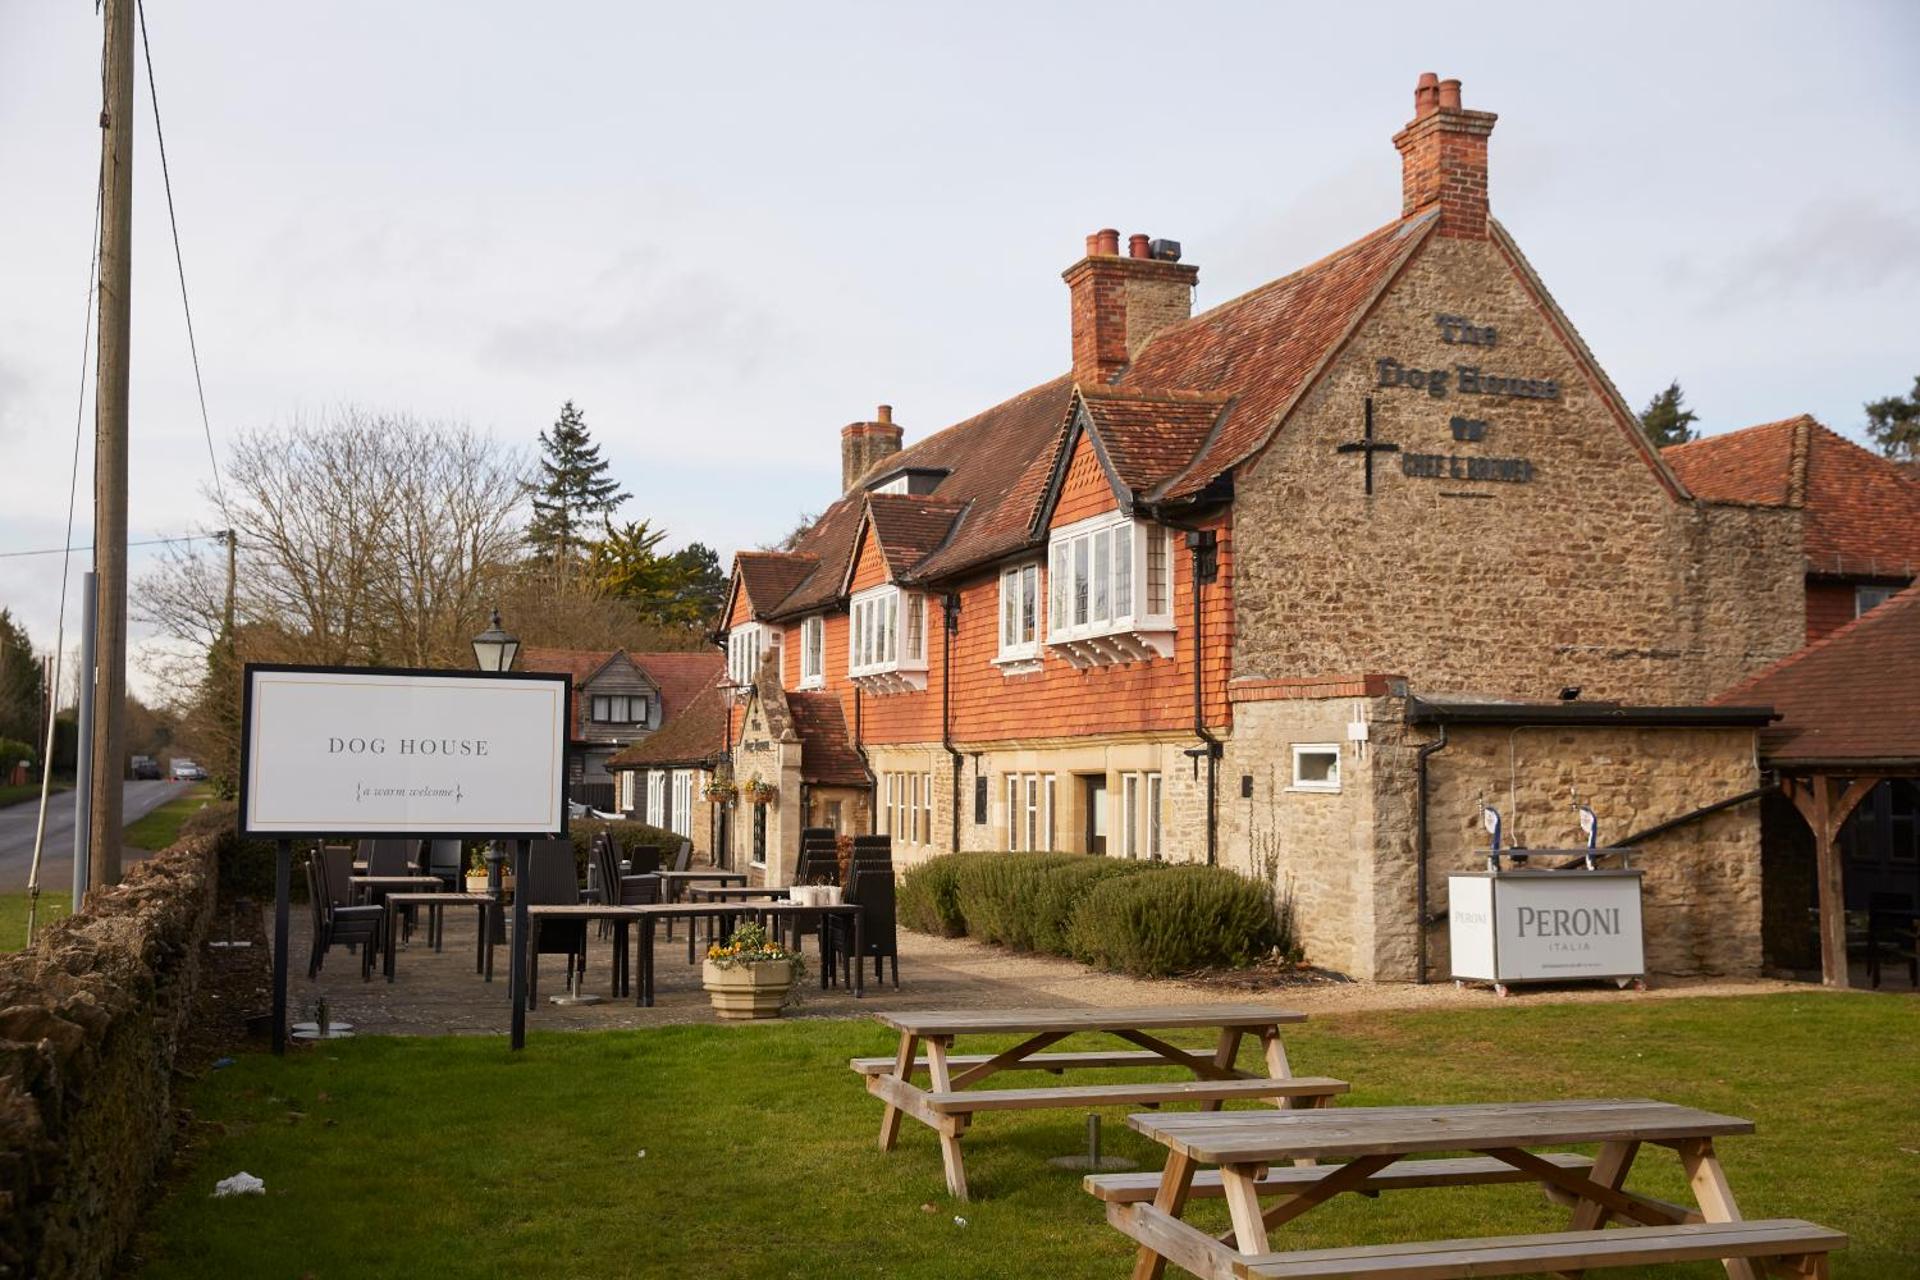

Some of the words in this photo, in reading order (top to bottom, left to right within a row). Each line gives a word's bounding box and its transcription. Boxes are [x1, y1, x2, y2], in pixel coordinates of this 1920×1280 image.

[1435, 313, 1498, 347] The
[1377, 357, 1450, 398] Dog
[1456, 364, 1560, 399] House
[328, 737, 386, 755] DOG
[399, 739, 489, 756] HOUSE
[374, 787, 405, 797] warm
[1517, 906, 1621, 938] PERONI
[1548, 942, 1591, 953] ITALIA
